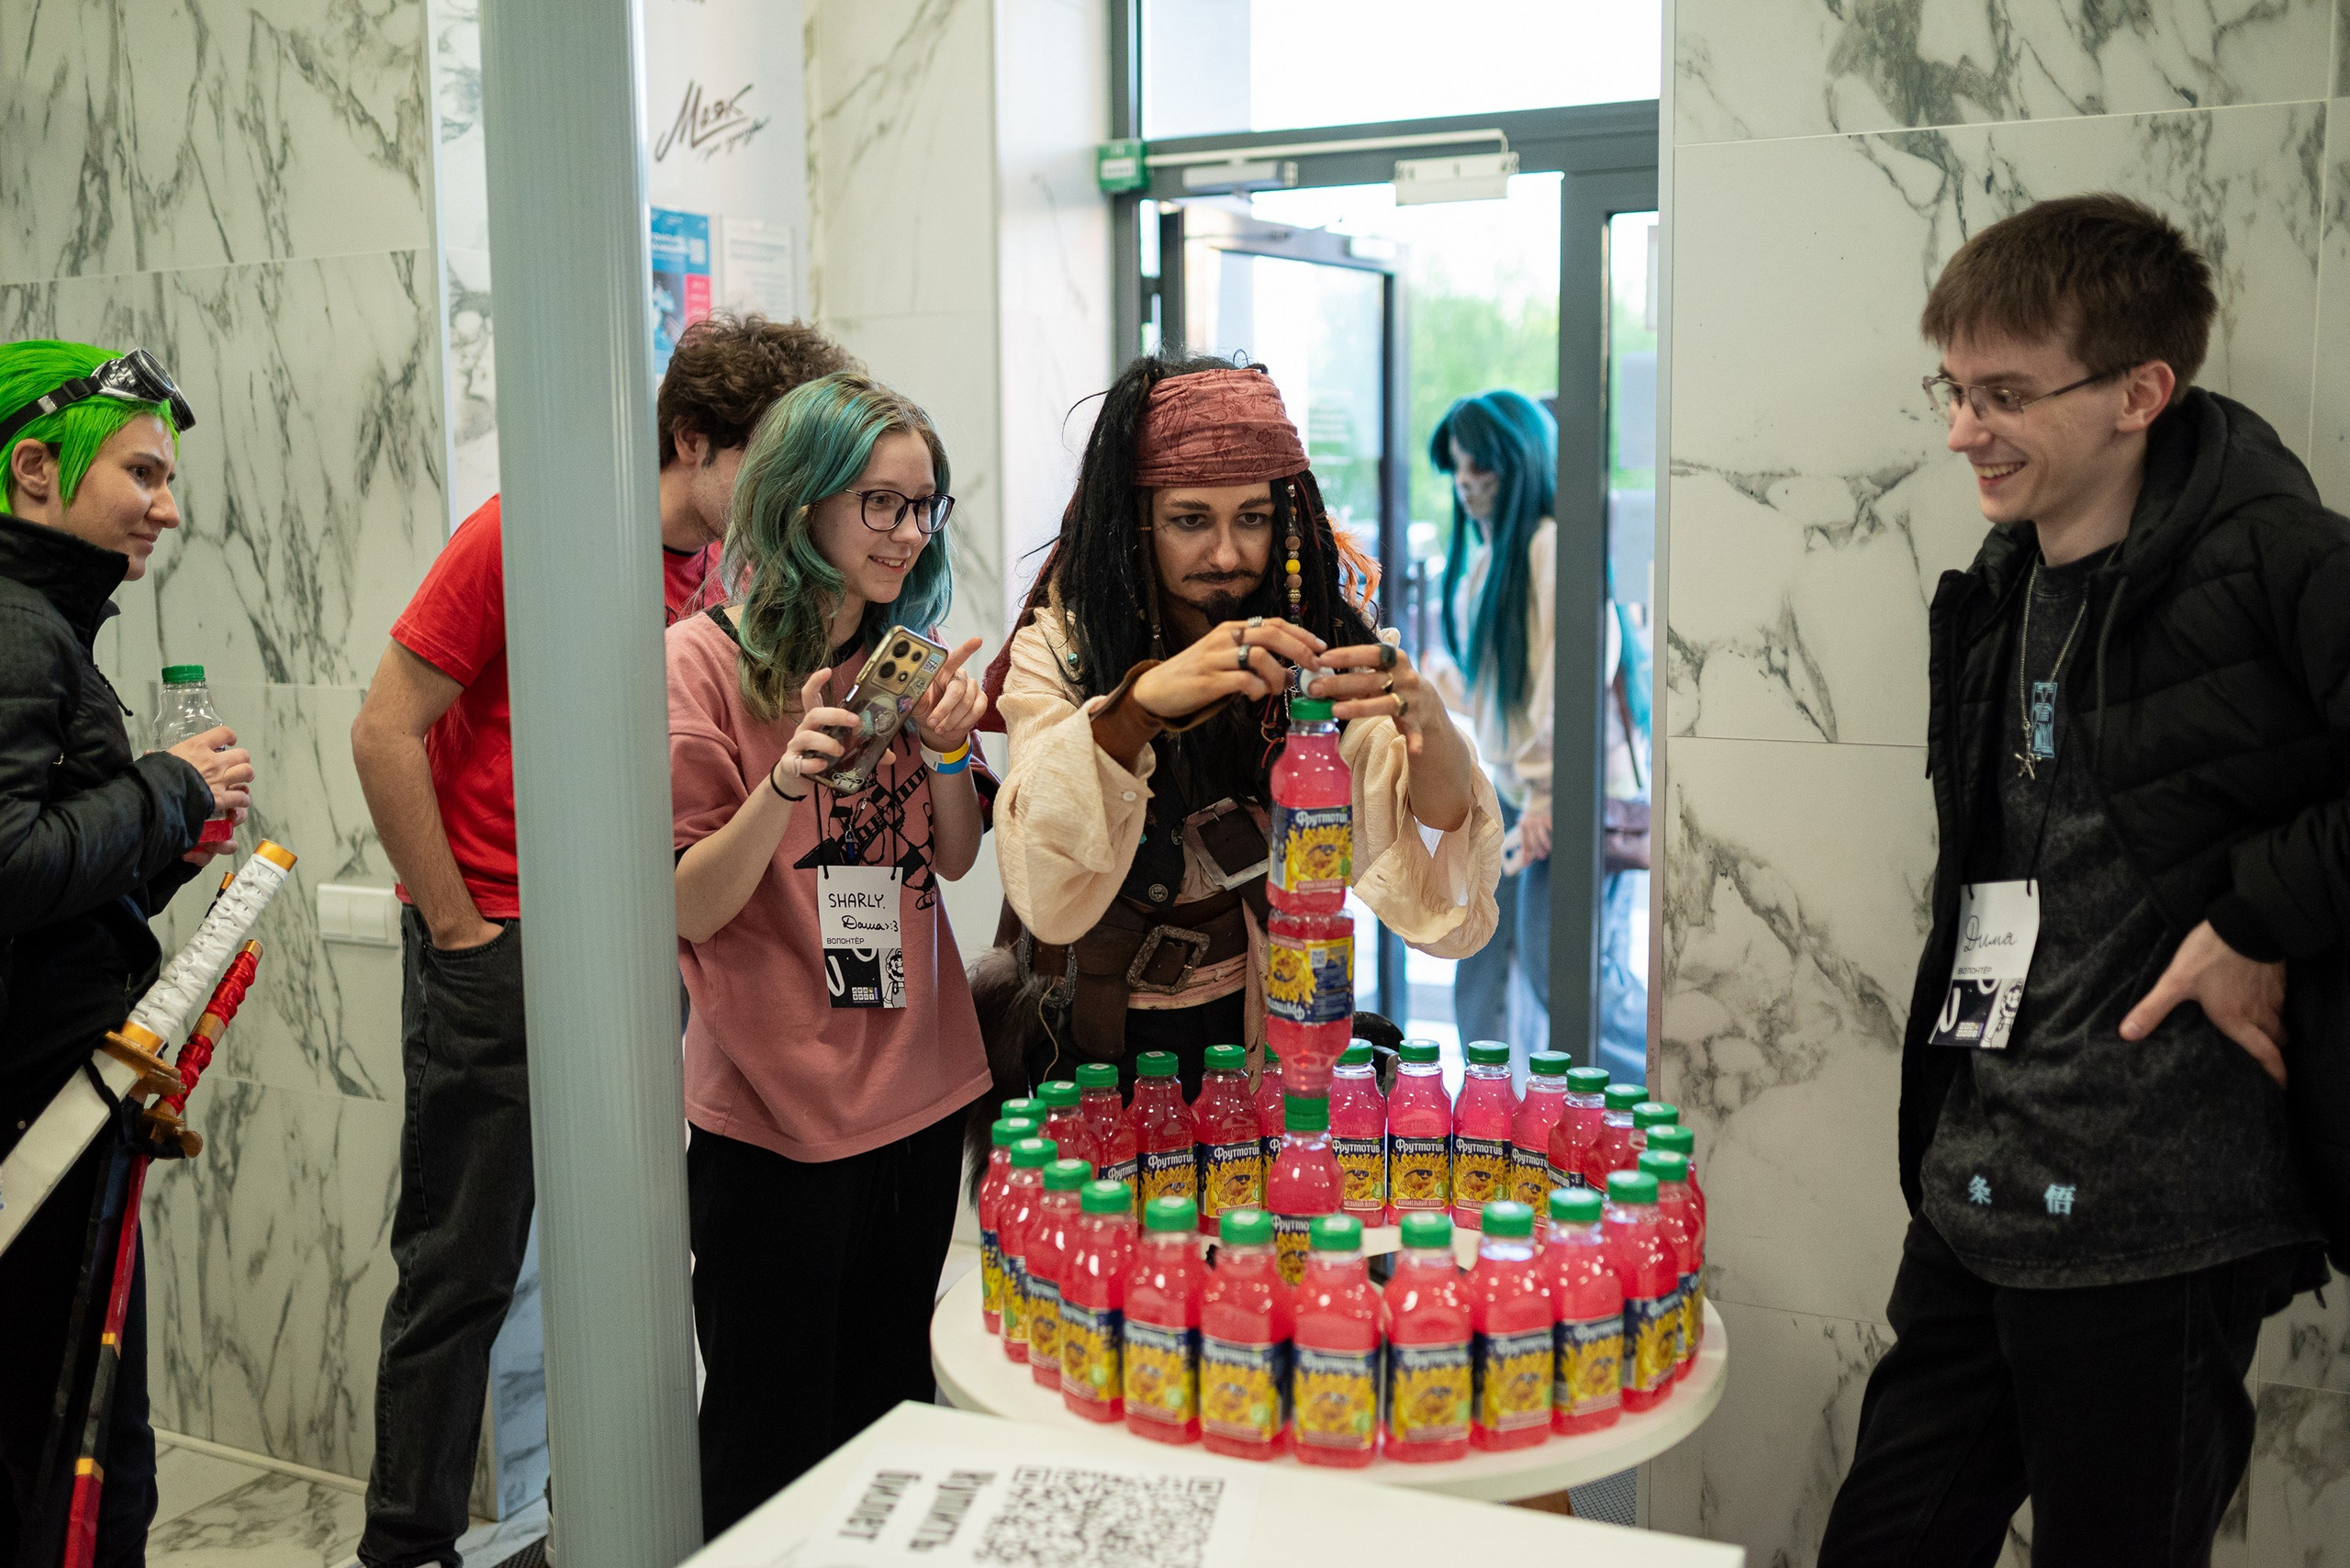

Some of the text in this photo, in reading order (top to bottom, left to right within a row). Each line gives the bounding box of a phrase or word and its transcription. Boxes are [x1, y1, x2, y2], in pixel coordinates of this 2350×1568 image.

[828, 892, 886, 909] SHARLY.
[1964, 915, 2019, 952] Дима
[1332, 1138, 1381, 1154] Фрутмотив
[1395, 1138, 1445, 1154] Фрутмотив
[1456, 1138, 1504, 1156] Фрутмотив
[1512, 1148, 1549, 1169] Фрутмоти
